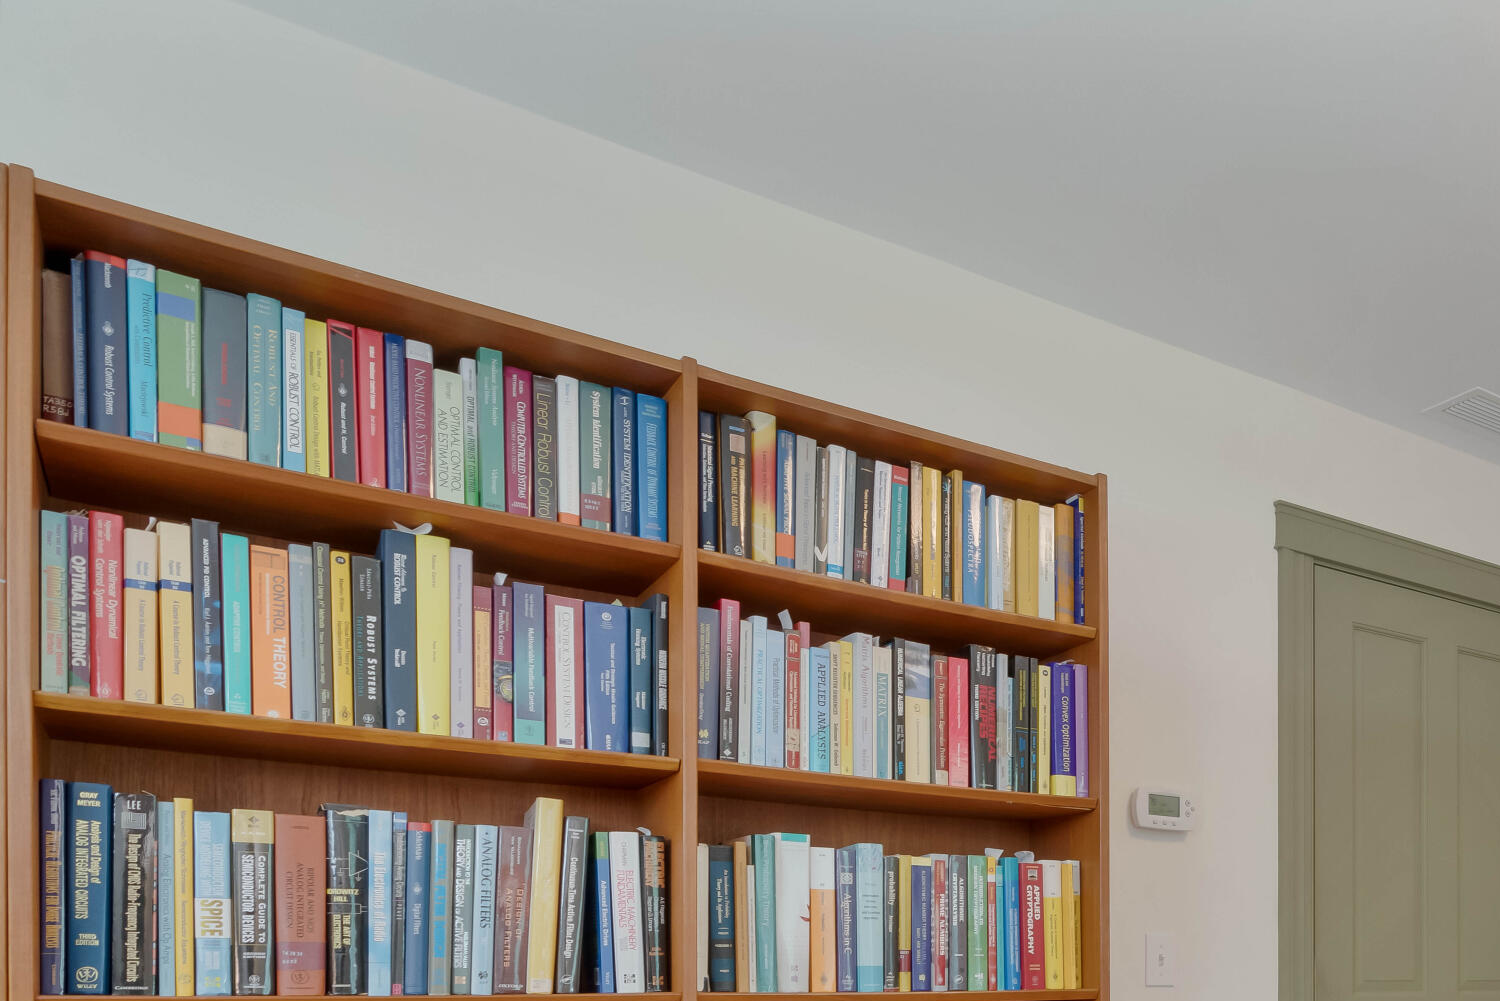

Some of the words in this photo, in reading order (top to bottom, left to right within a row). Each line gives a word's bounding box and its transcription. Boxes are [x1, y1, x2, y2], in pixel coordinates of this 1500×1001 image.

[142, 293, 152, 334] Predictive
[105, 345, 113, 366] Robust
[143, 337, 152, 366] Control
[105, 368, 113, 389] Control
[105, 391, 114, 415] Systems
[414, 368, 426, 430] NONLINEAR
[536, 393, 552, 430] Linear
[592, 391, 600, 417] System
[438, 408, 448, 432] AND
[450, 406, 460, 448] OPTIMAL
[623, 419, 631, 450] SYSTEM
[415, 433, 427, 476] SYSTEMS
[438, 432, 449, 487] ESTIMATION
[537, 433, 551, 474] Robust
[592, 419, 602, 469] Identification
[450, 450, 461, 493] CONTROL
[624, 452, 632, 513] IDENTIFICATION
[537, 477, 552, 519] Control
[72, 555, 85, 606] OPTIMAL
[96, 558, 105, 586] Control
[108, 559, 117, 597] Nonlinear
[94, 588, 105, 618] Systems
[106, 599, 118, 639] Dynamical
[273, 575, 286, 633] CONTROL
[72, 609, 86, 666] FILTERING
[366, 615, 376, 653] ROBUST
[273, 637, 286, 688] THEORY
[367, 658, 378, 700] SYSTEMS
[1061, 696, 1070, 722] Convex
[818, 711, 826, 759] ANALYSIS
[1061, 724, 1070, 772] Optimization
[127, 800, 141, 810] LEE
[75, 820, 88, 846] ANALOG
[90, 820, 101, 844] Analysis
[91, 845, 101, 856] and
[75, 848, 88, 887] INTEGRATED
[89, 857, 101, 873] Design
[91, 875, 101, 884] of
[480, 838, 492, 887] ANALOG
[241, 854, 254, 912] SEMICONDUCTOR
[75, 890, 88, 919] CIRCUITS
[200, 900, 223, 936] SPICE
[480, 890, 492, 928] FILTERS
[242, 915, 253, 943] DEVICES
[258, 932, 265, 943] TO
[333, 914, 341, 949] ELECTRONICS
